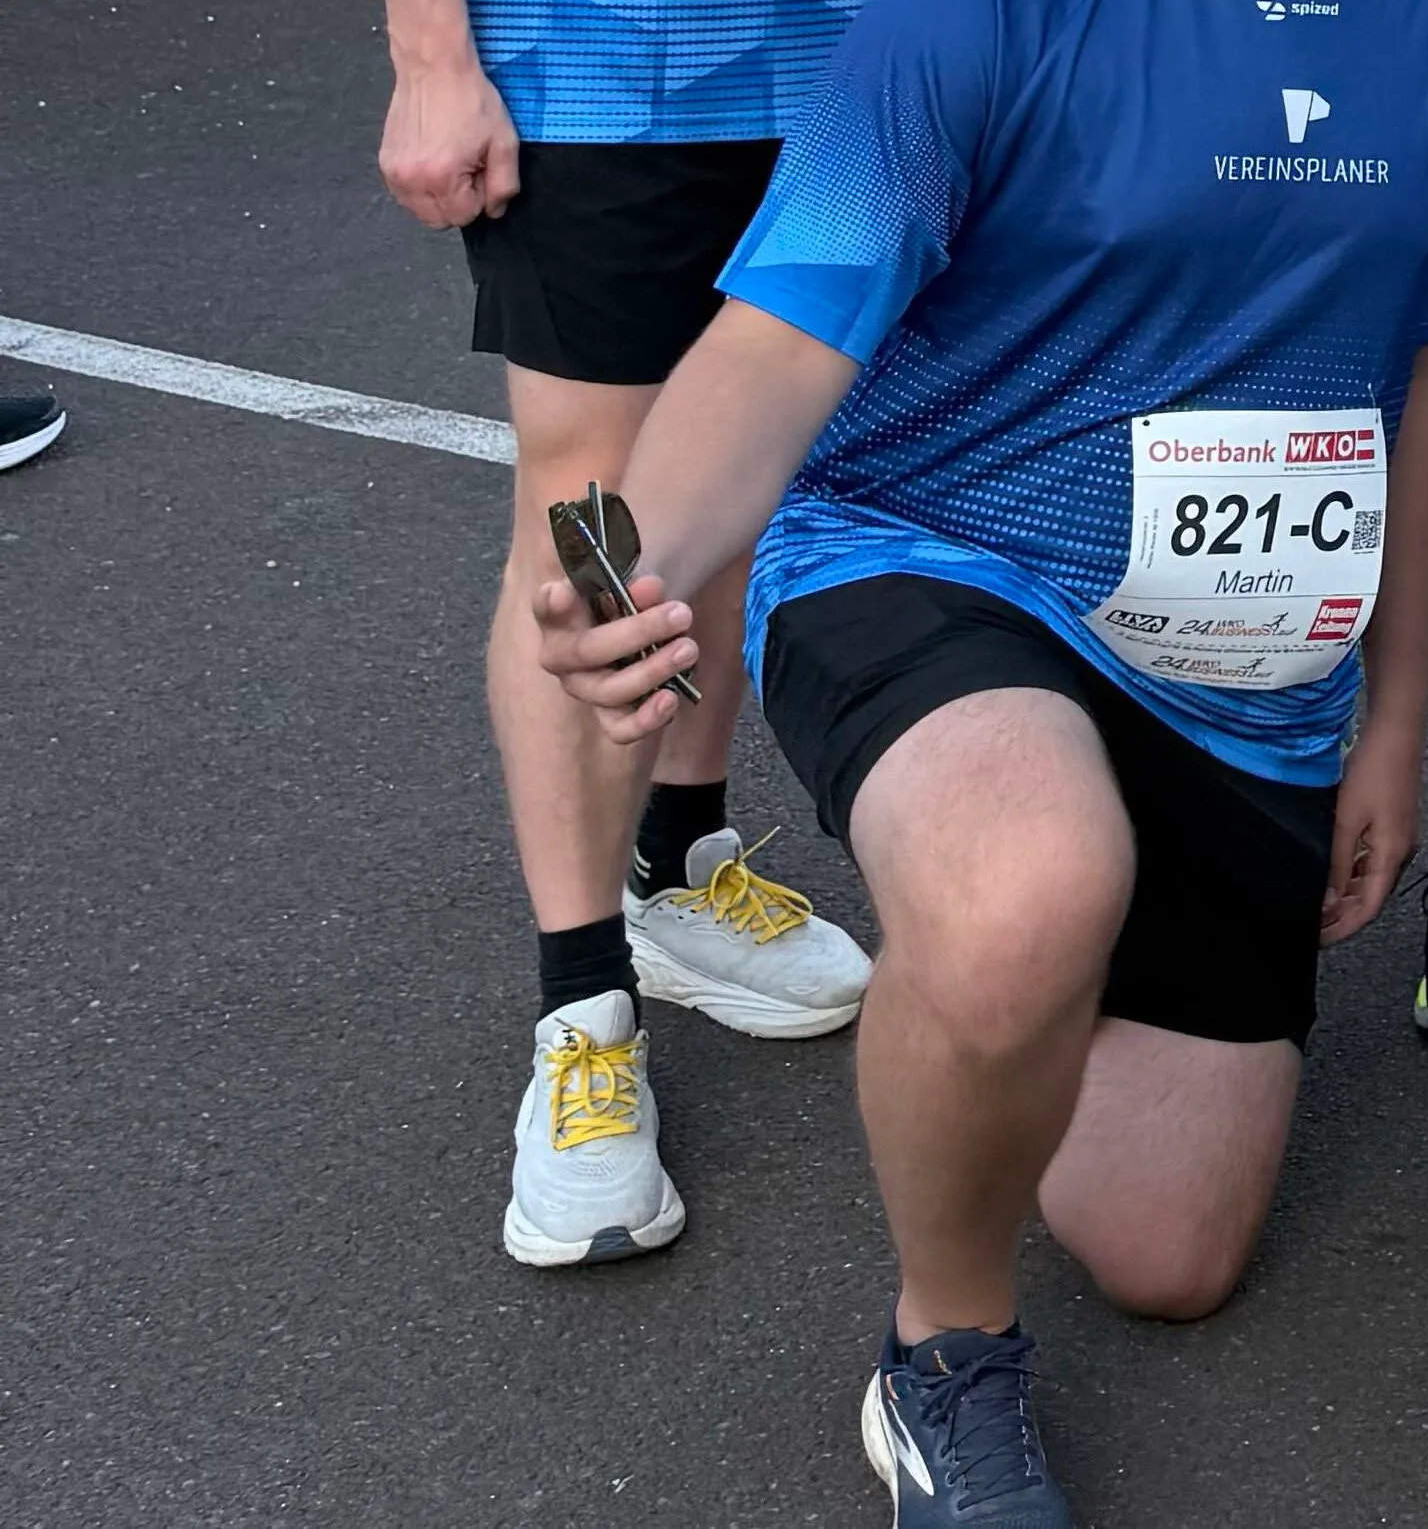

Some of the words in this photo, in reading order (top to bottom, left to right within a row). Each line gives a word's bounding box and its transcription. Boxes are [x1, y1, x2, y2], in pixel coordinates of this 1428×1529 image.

[1291, 0, 1340, 18] spized
[1214, 155, 1389, 184] VEREINSPLANER
[1149, 438, 1277, 464] Oberbank
[1288, 433, 1356, 463] WKO
[1170, 489, 1354, 557] 821-C
[1215, 569, 1293, 595] Martin
